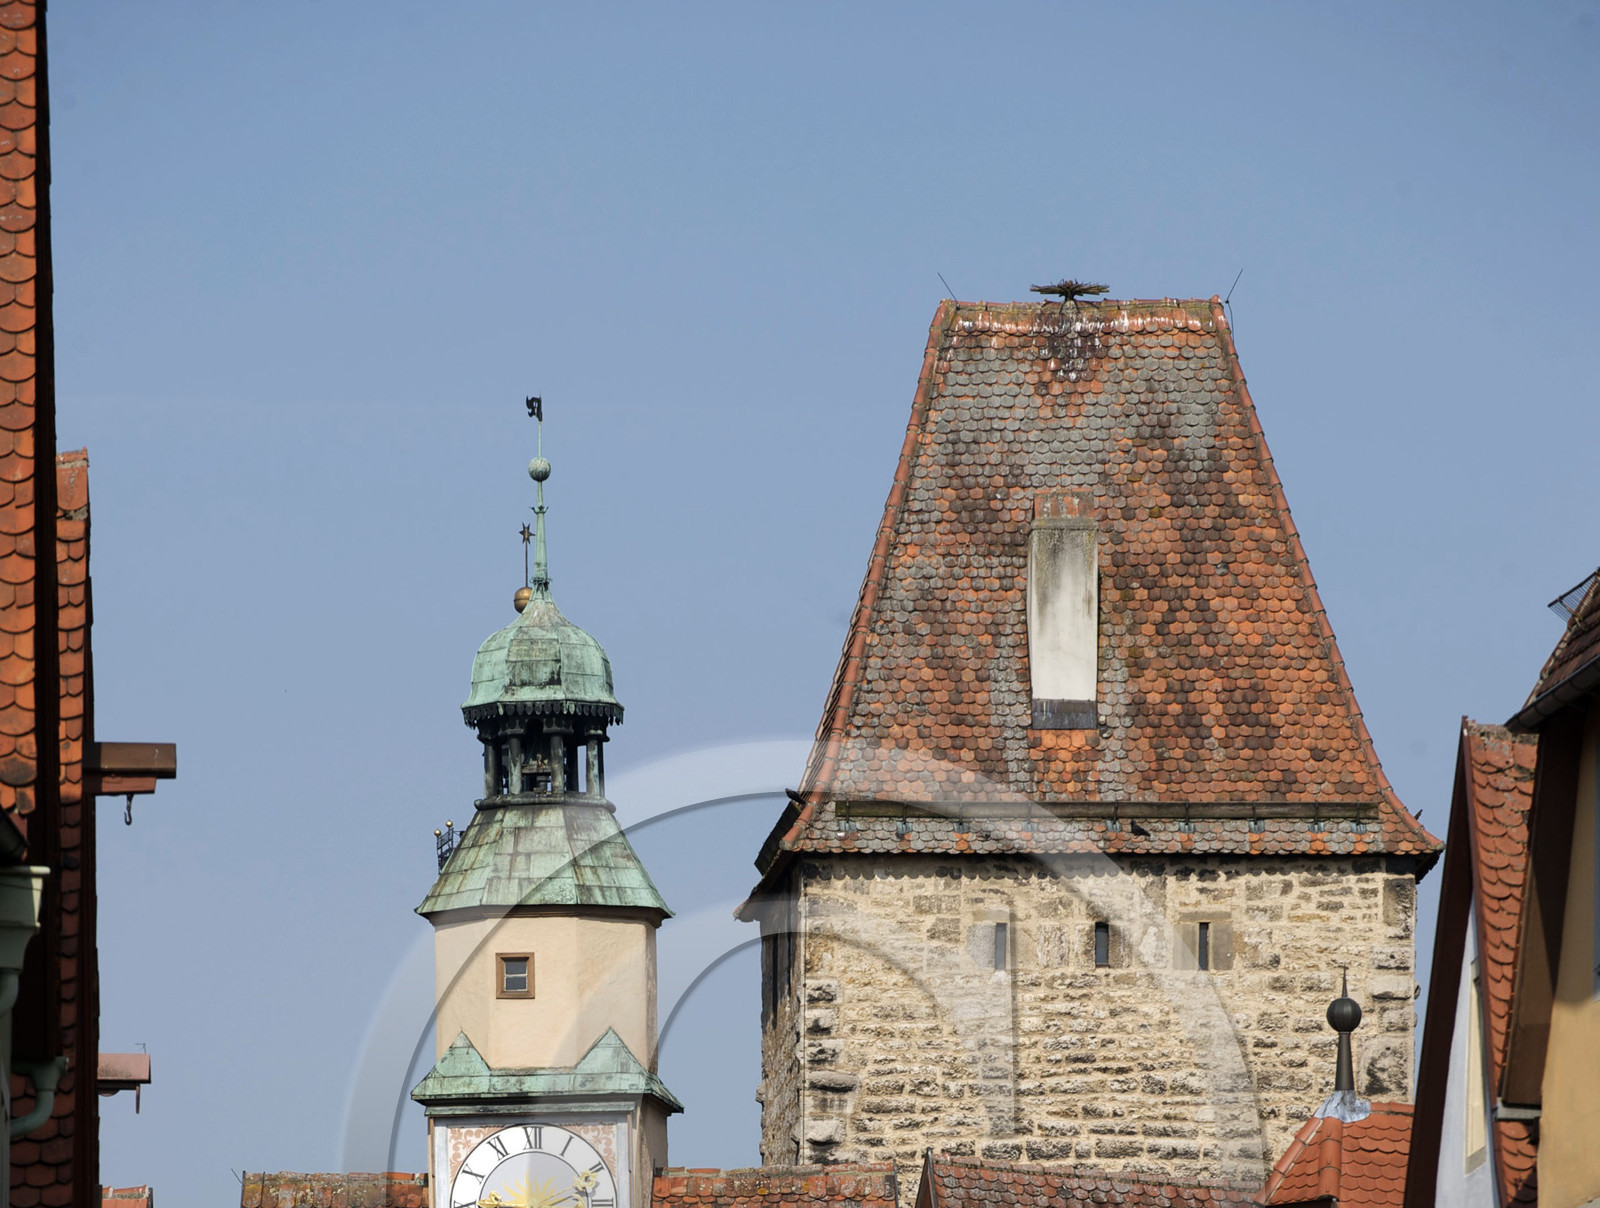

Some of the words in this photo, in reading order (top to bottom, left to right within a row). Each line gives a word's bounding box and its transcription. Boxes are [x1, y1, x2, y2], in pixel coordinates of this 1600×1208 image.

[486, 1135, 510, 1161] XI
[523, 1126, 544, 1150] XII
[559, 1134, 574, 1157] I
[462, 1164, 486, 1184] X
